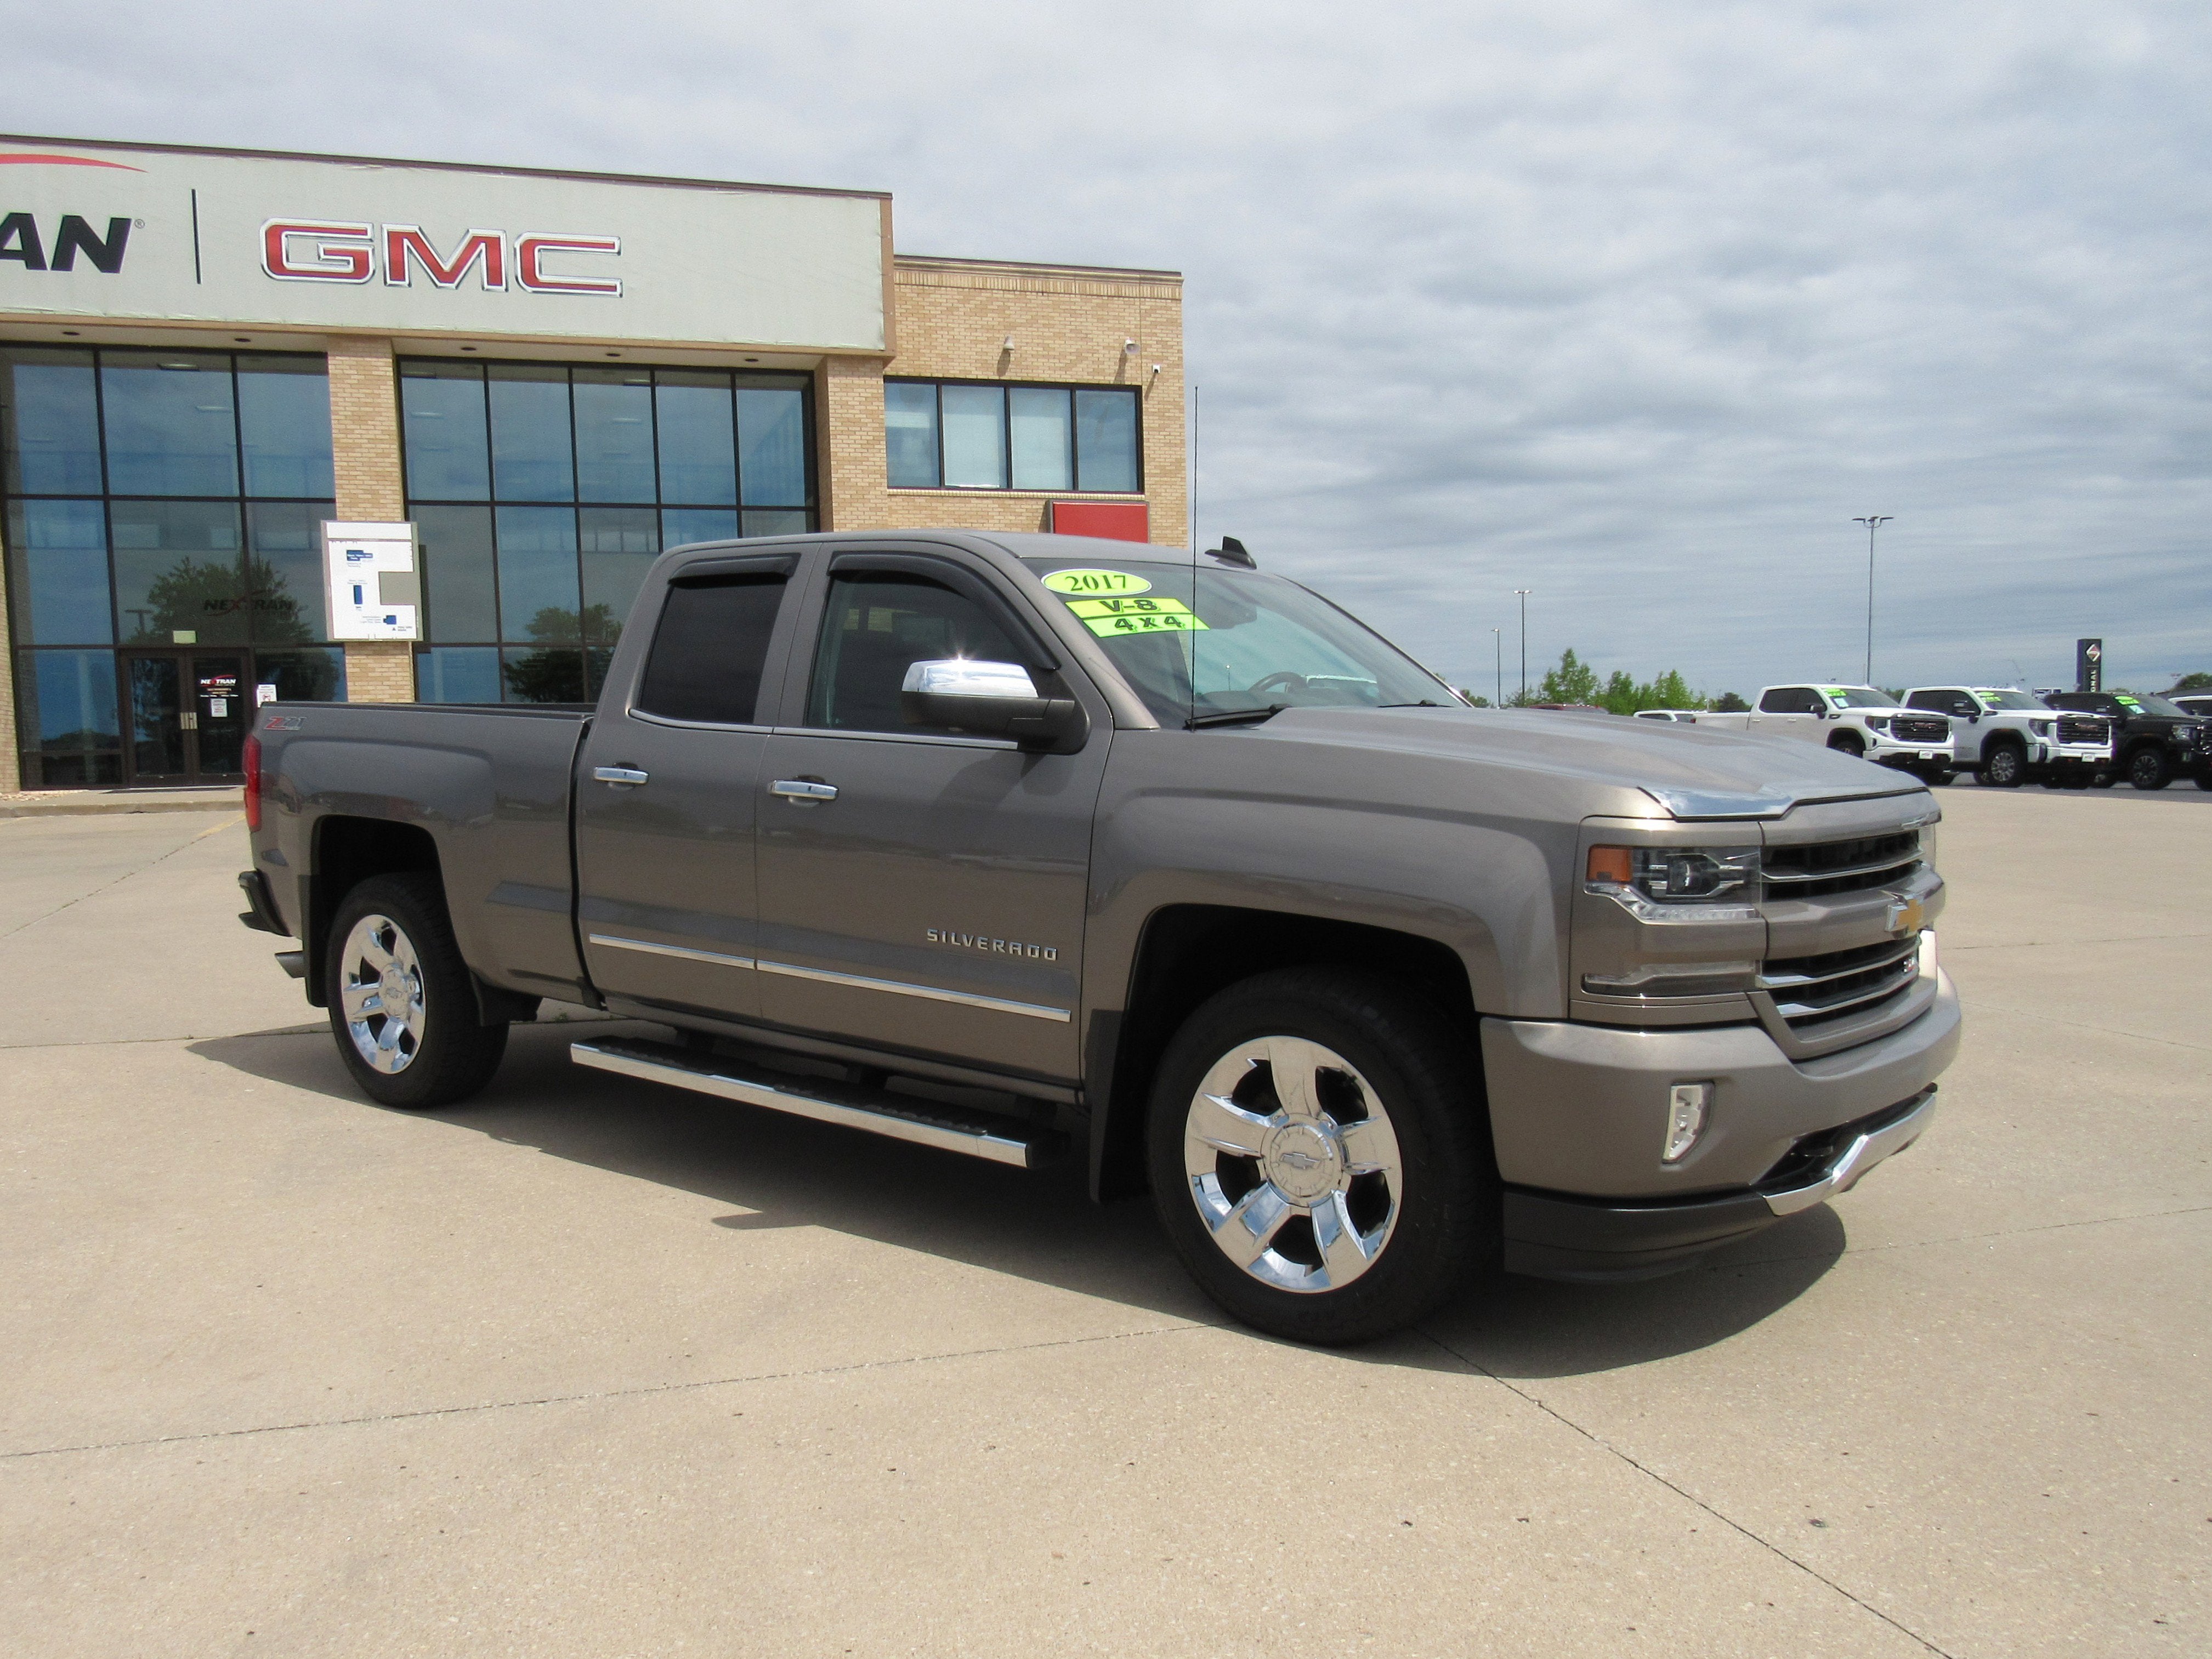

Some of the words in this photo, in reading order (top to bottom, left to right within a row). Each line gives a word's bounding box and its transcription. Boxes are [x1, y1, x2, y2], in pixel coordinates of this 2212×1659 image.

[259, 217, 623, 298] GMC
[1064, 574, 1127, 592] 2017
[1099, 599, 1159, 612] V-8
[926, 928, 1058, 961] SILVERADO
